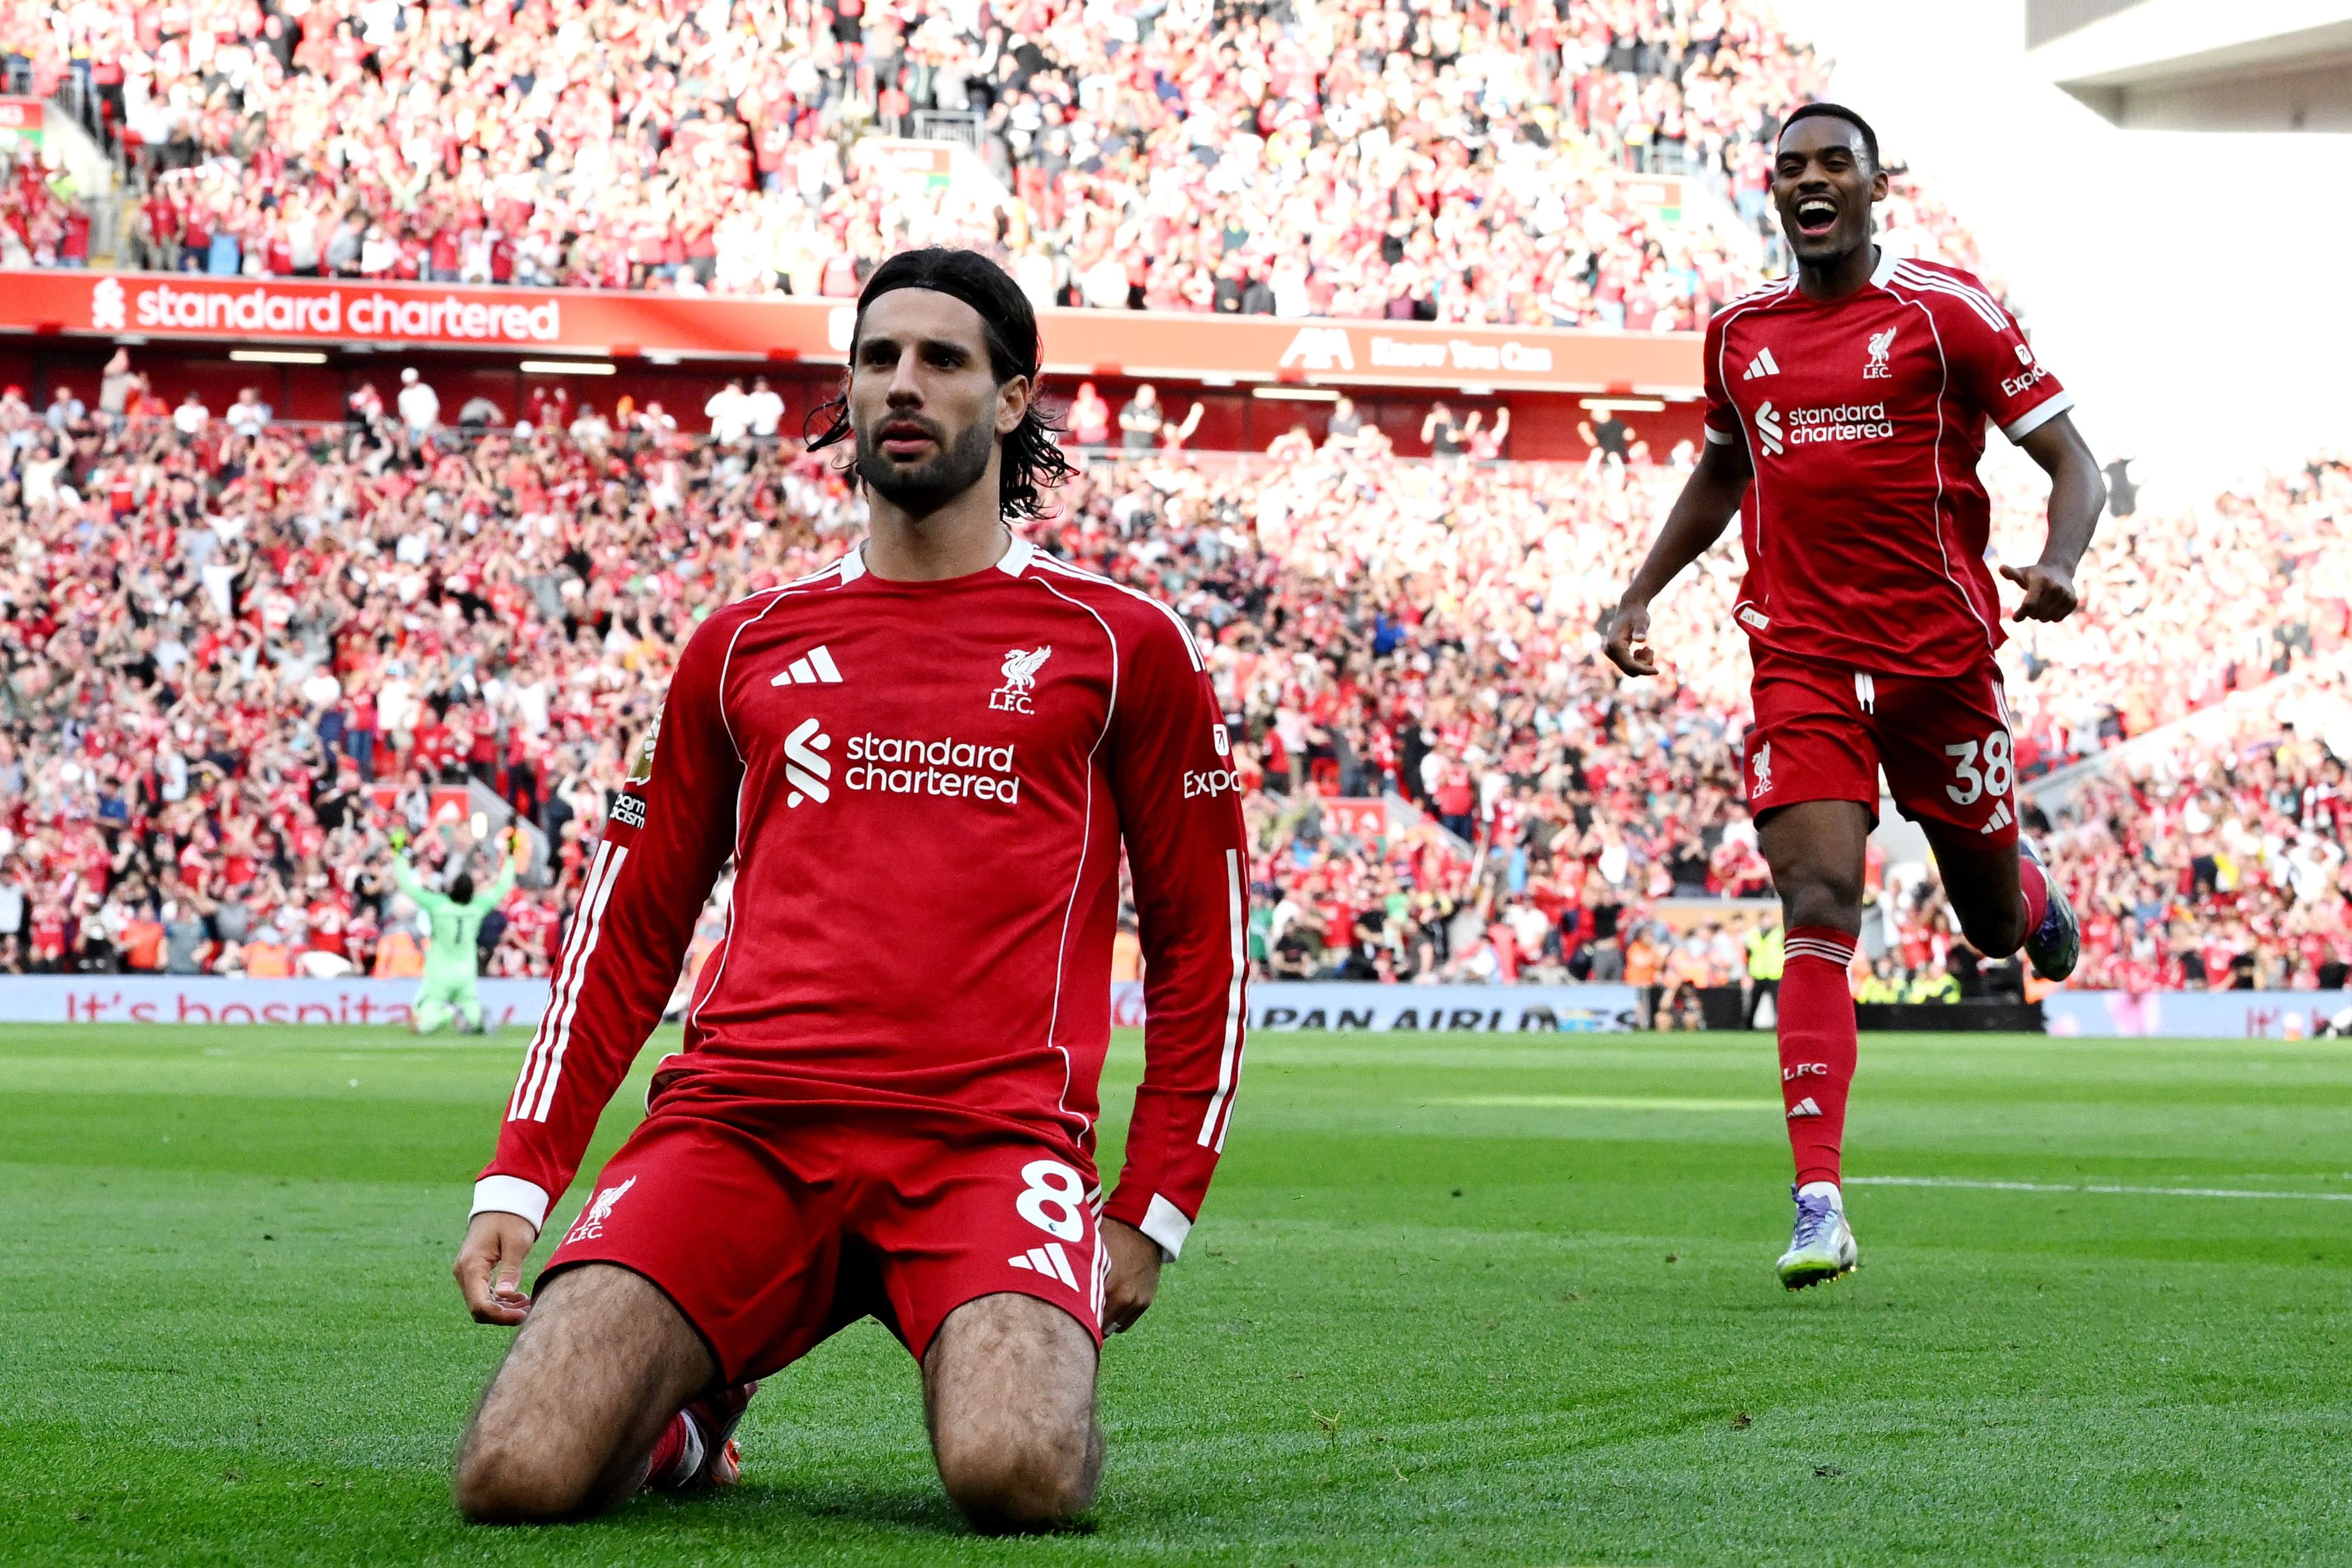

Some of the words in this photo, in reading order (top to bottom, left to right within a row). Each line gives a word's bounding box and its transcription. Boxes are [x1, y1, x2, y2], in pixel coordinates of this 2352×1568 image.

[137, 283, 341, 333] standard
[347, 292, 560, 340] chartered
[1789, 401, 1885, 426] standard
[1790, 420, 1894, 444] chartered
[846, 732, 1015, 772] standard
[1945, 730, 2011, 805] 38
[845, 763, 1020, 804] chartered
[1016, 1159, 1085, 1243] 8
